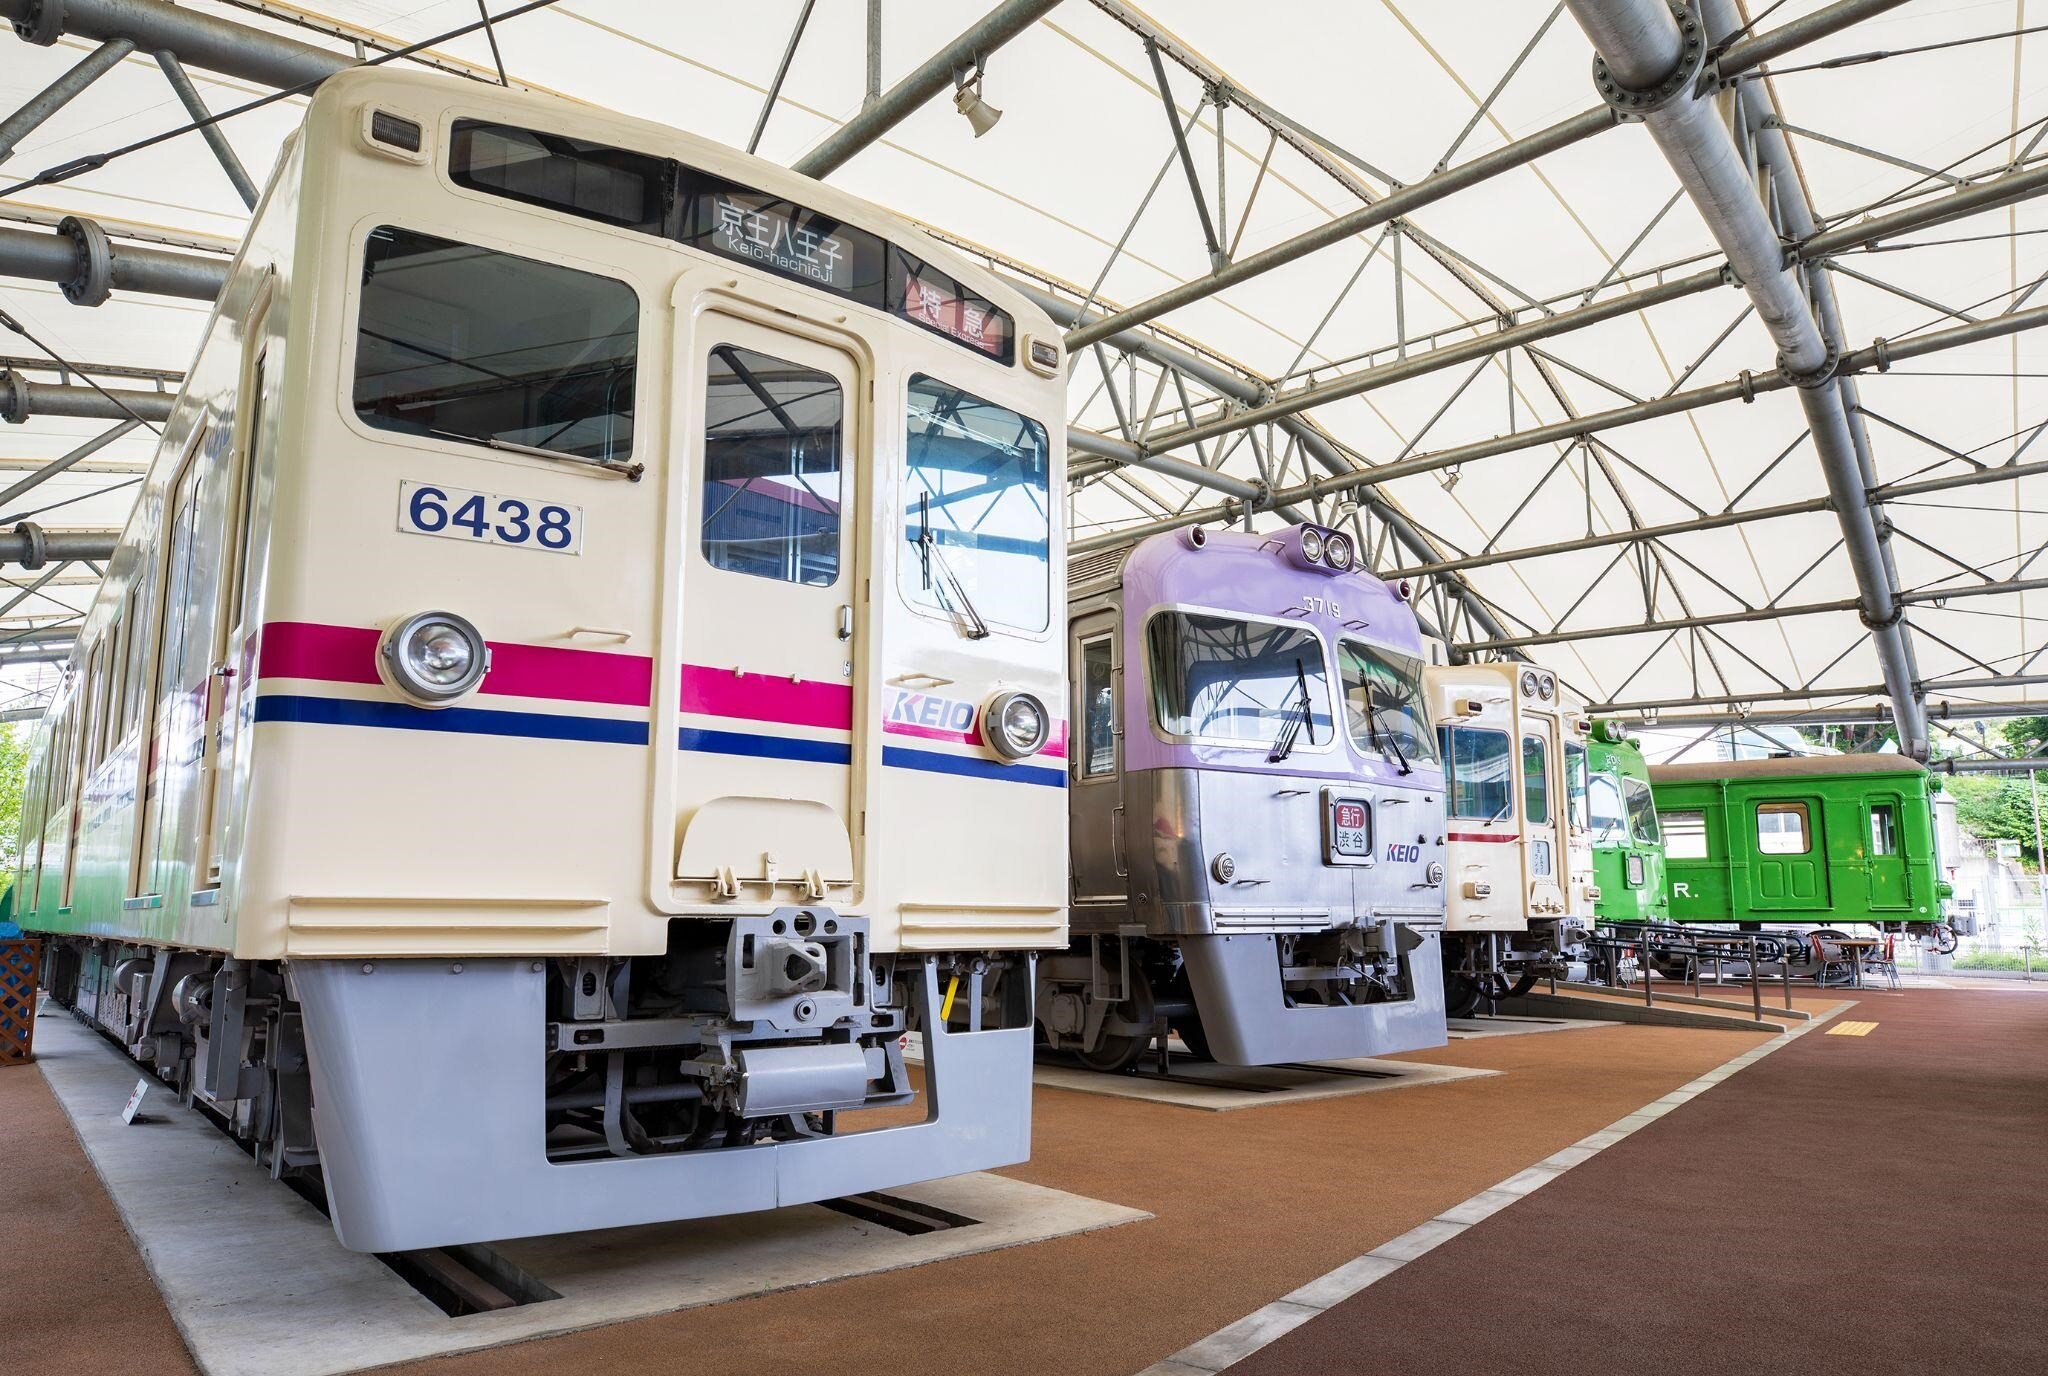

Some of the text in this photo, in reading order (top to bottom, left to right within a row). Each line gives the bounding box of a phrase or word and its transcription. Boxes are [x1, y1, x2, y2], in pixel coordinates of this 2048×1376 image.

[718, 202, 843, 270] 京王八王子
[409, 487, 572, 549] 6438
[1302, 595, 1341, 618] 3719
[891, 692, 974, 731] KEIO
[1341, 806, 1361, 827] 急行
[1339, 831, 1363, 849] 渋谷
[1386, 843, 1420, 863] KEIO
